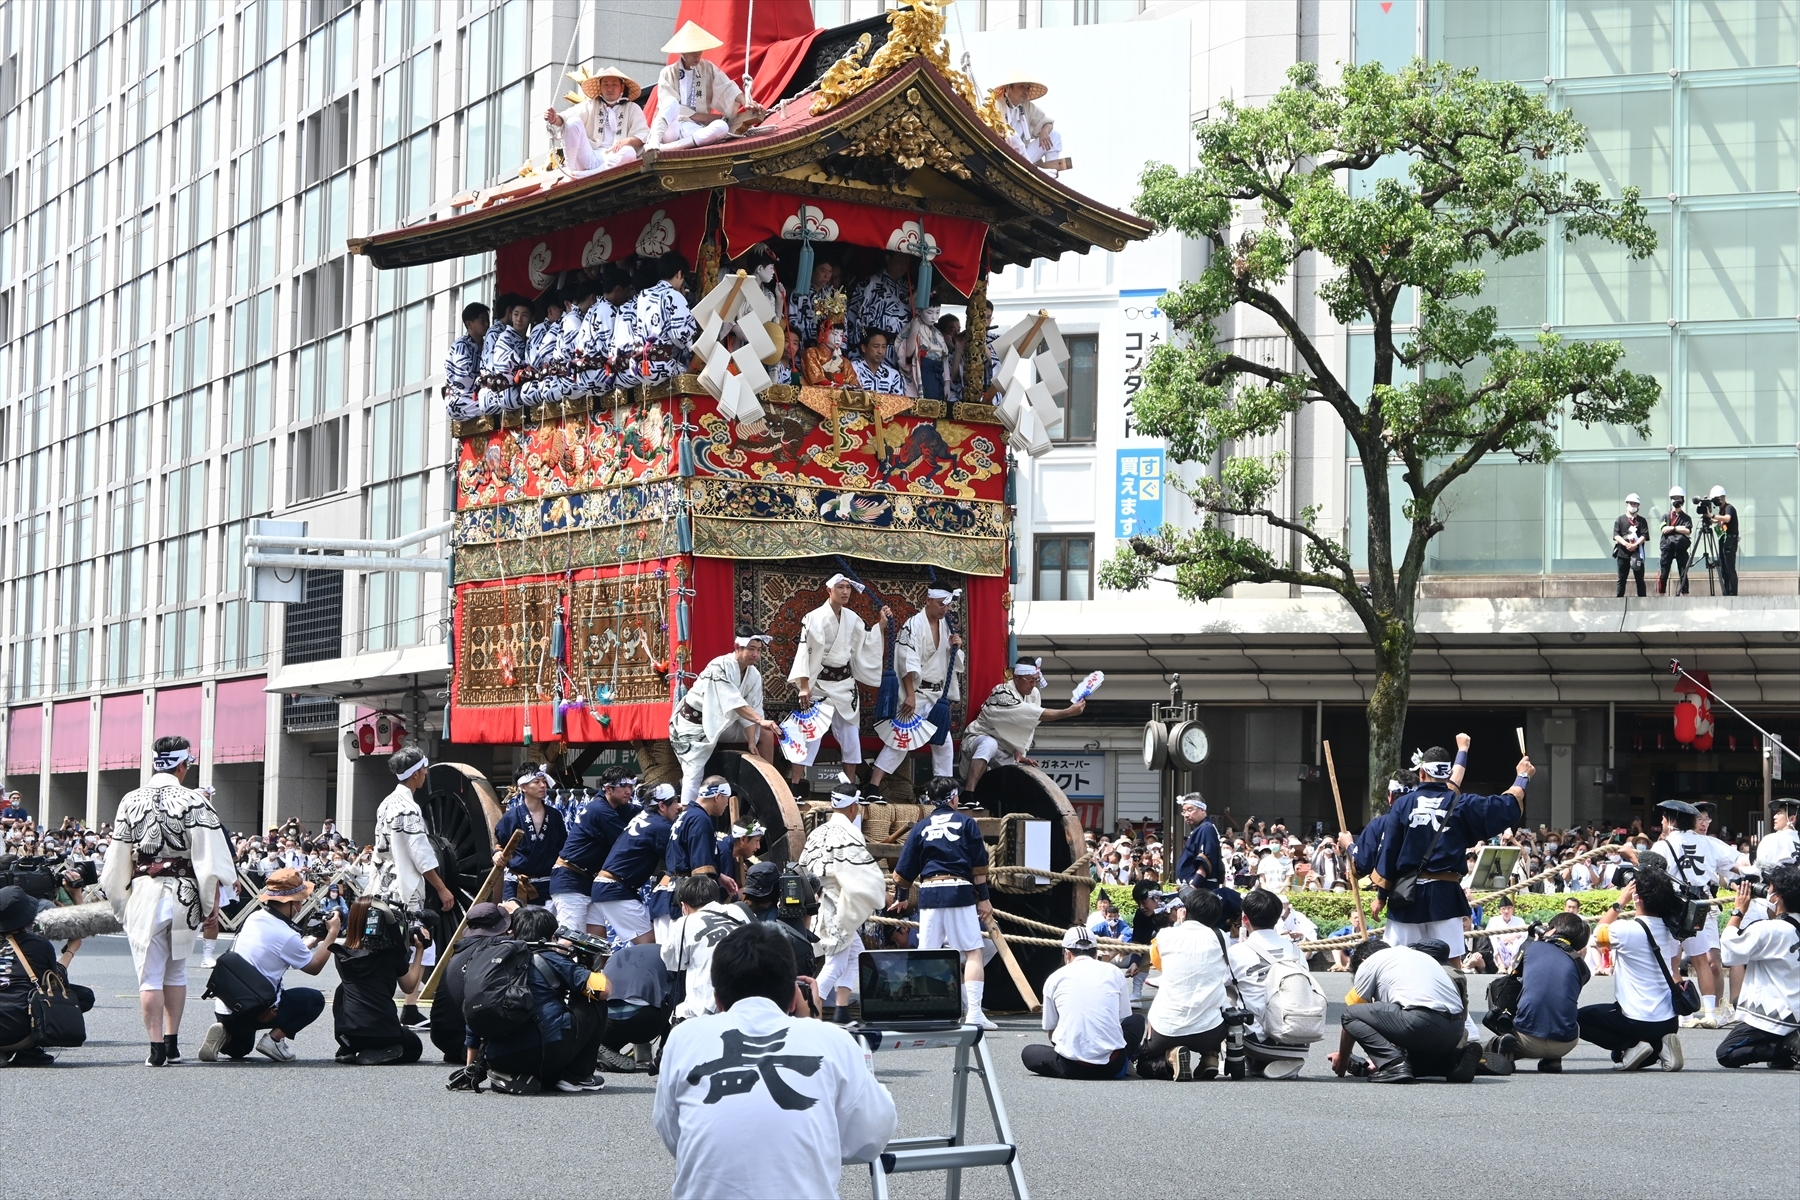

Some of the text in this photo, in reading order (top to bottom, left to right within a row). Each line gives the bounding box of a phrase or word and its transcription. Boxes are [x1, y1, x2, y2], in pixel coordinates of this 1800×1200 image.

[1142, 459, 1158, 498] すぐ
[1120, 457, 1139, 536] 買えます
[1037, 760, 1090, 769] ガネスーパー
[1046, 773, 1090, 791] クト
[920, 812, 963, 842] 長
[1408, 796, 1451, 832] 長
[1678, 843, 1708, 876] 長
[686, 1027, 825, 1111] 長
